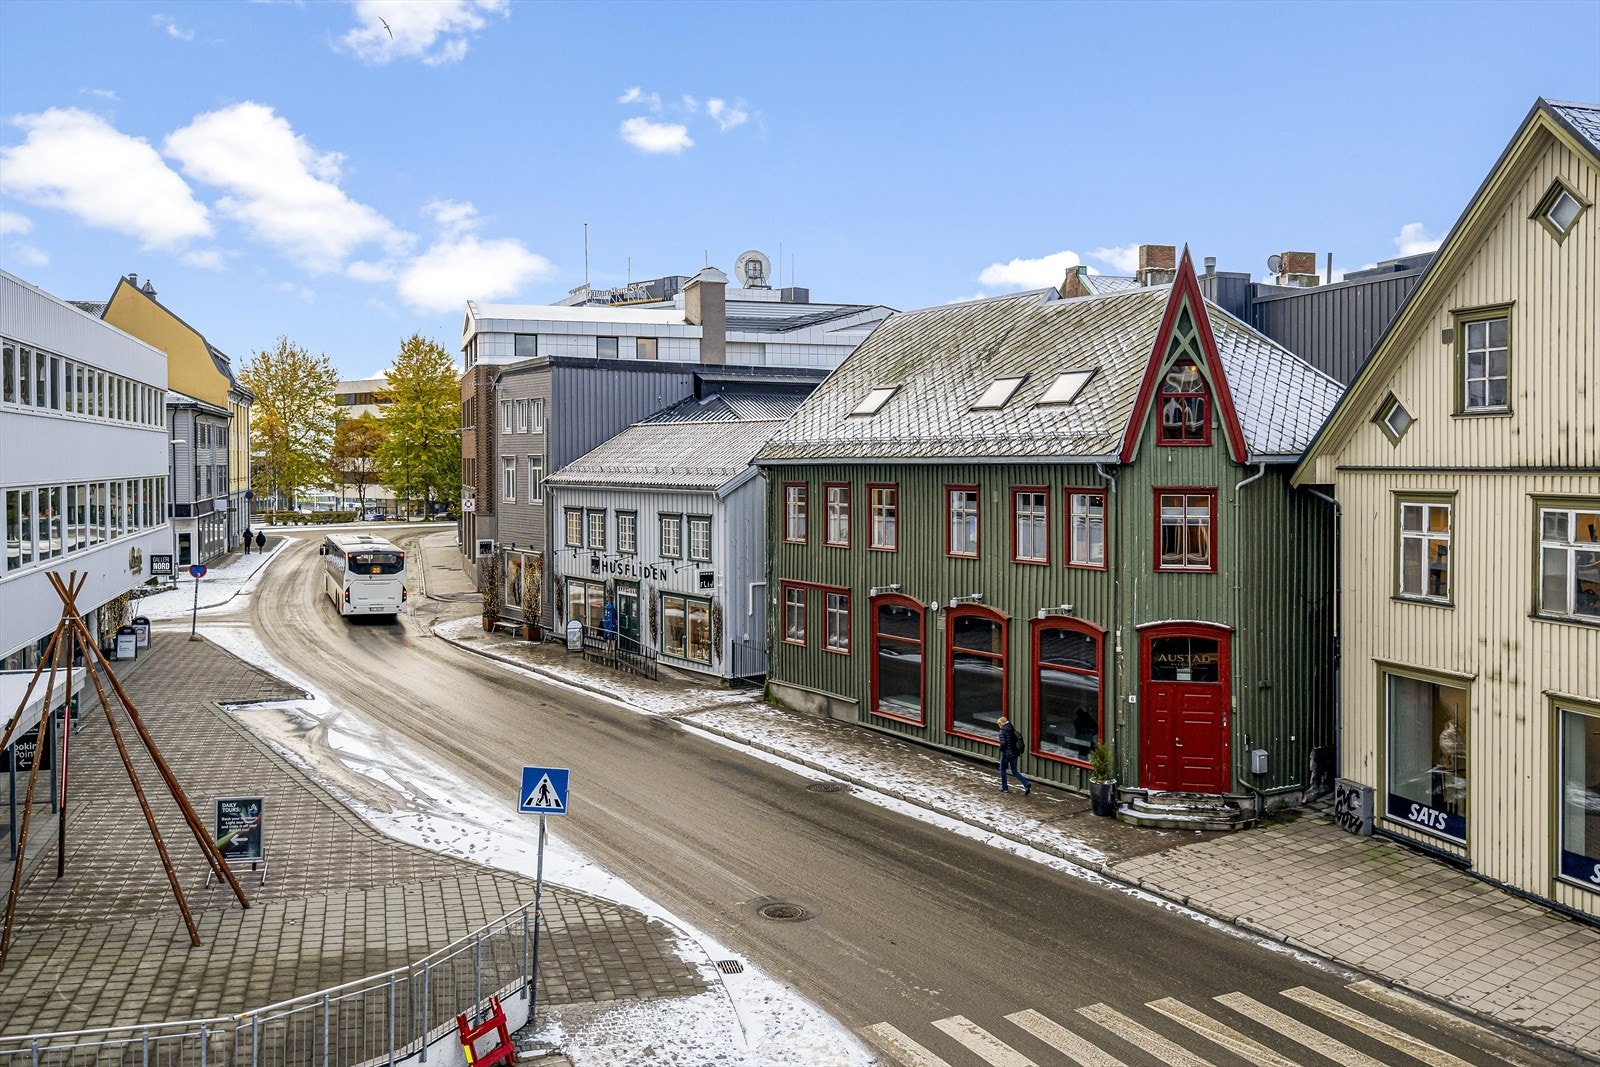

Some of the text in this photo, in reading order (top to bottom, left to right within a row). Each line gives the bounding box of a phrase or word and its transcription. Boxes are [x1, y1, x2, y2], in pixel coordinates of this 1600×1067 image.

[152, 562, 170, 570] NORD
[1158, 653, 1211, 663] AUSTAD
[1408, 803, 1448, 830] SATS
